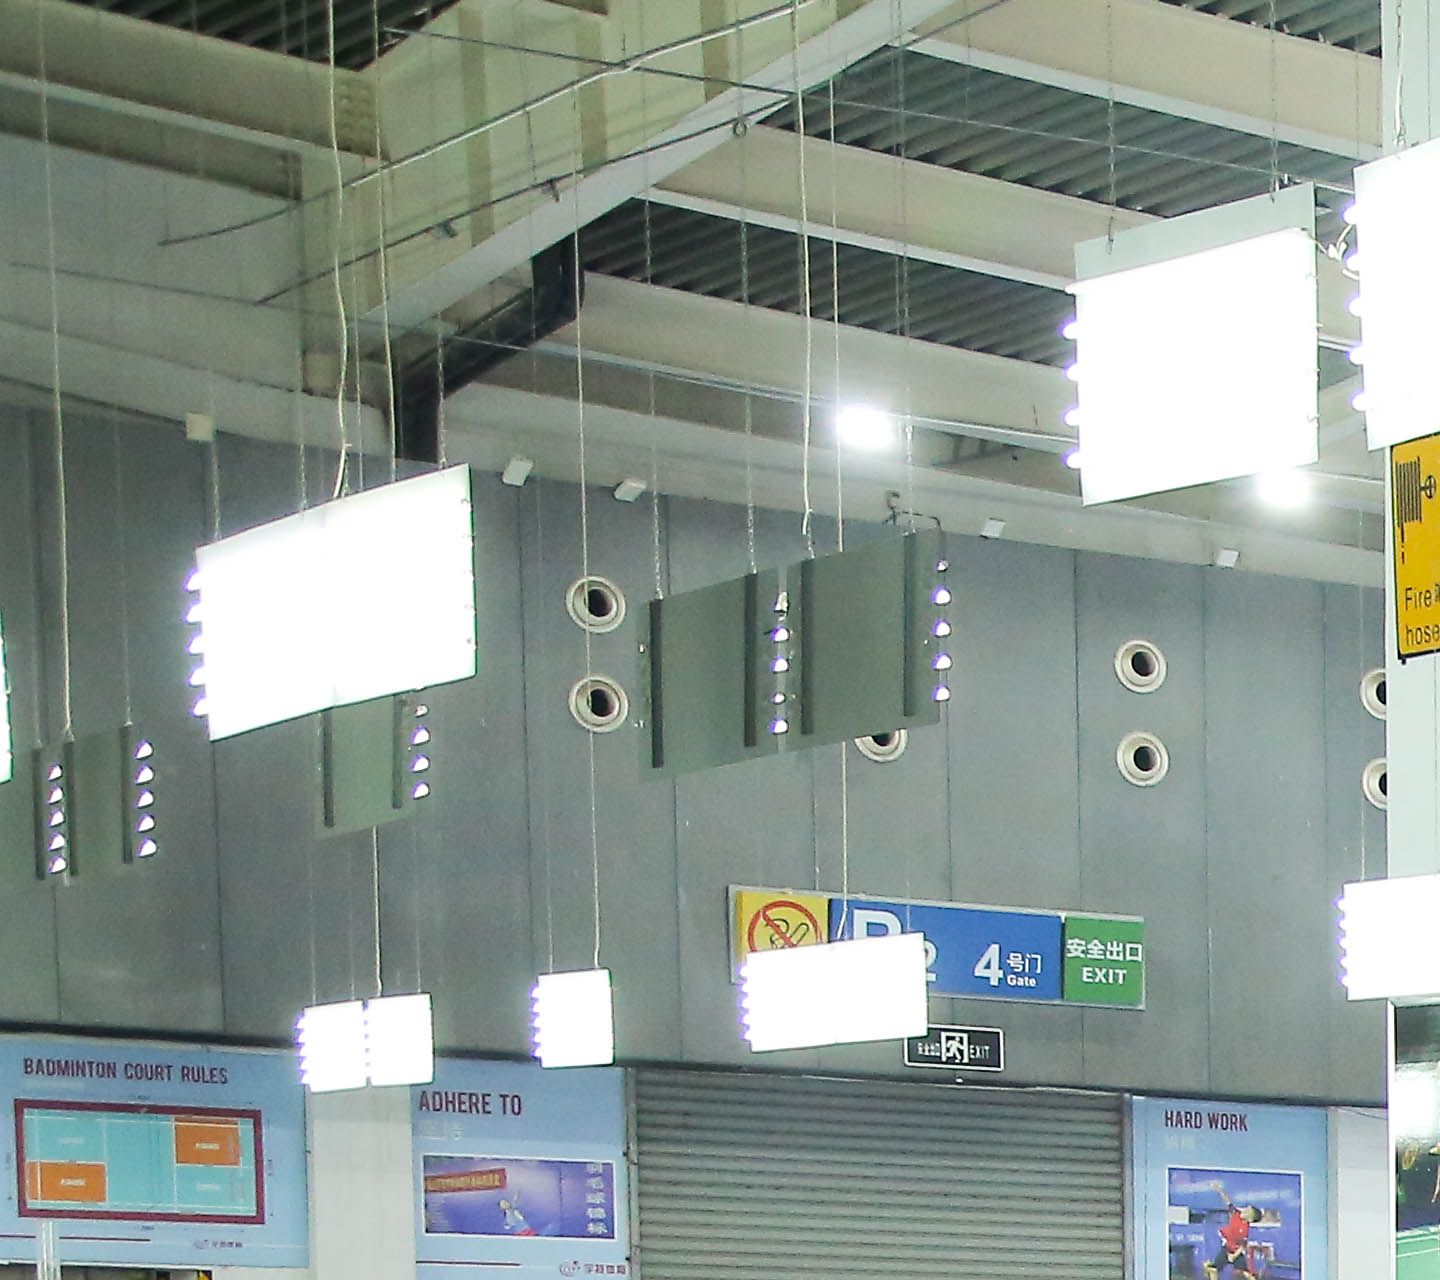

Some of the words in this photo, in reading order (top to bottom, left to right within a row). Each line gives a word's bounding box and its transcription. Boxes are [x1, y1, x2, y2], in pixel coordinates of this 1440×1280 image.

[1405, 587, 1432, 611] Fire
[1406, 624, 1440, 646] hose
[1066, 938, 1142, 961] 安全出口
[974, 943, 1004, 986] 4
[1007, 952, 1042, 975] 号门
[1007, 974, 1036, 988] Gate
[1082, 967, 1127, 985] EXIT
[969, 1044, 990, 1060] EXIT
[24, 1058, 117, 1079] BADMINTON
[124, 1063, 173, 1081] COURT
[181, 1065, 228, 1084] RULES
[419, 1091, 492, 1115] ADHERE
[499, 1093, 522, 1115] TO
[1164, 1110, 1203, 1129] HARD
[1207, 1112, 1248, 1132] WORK
